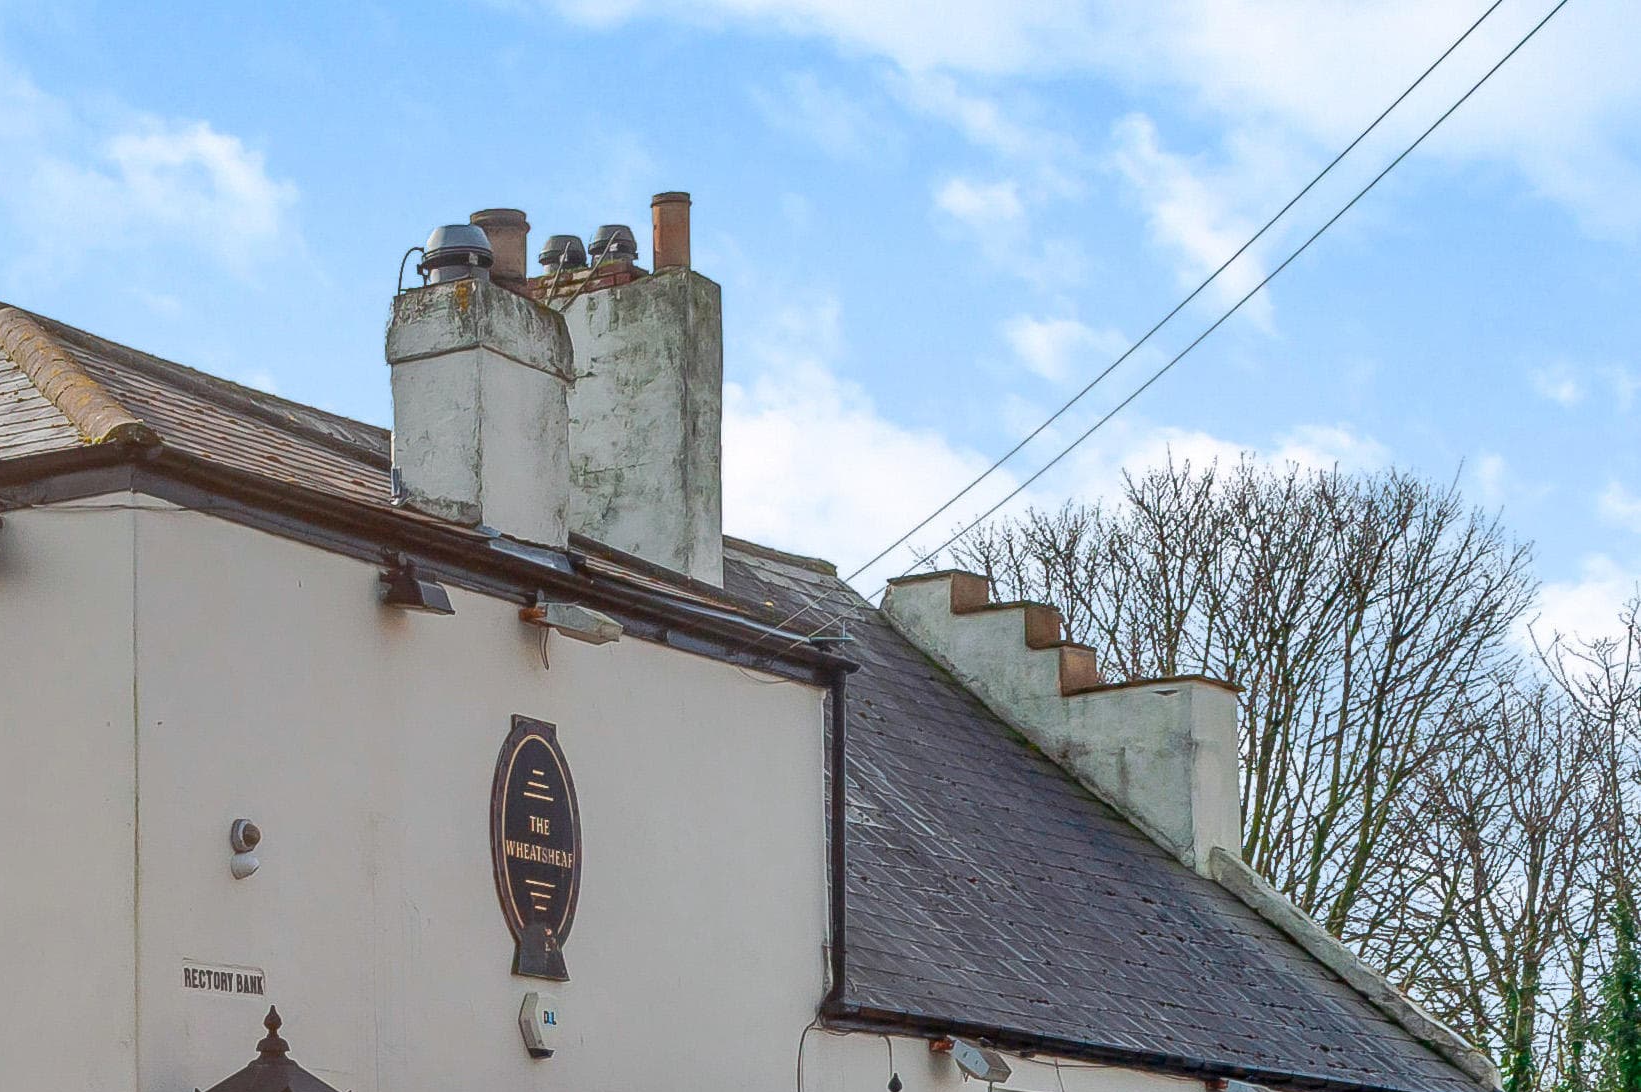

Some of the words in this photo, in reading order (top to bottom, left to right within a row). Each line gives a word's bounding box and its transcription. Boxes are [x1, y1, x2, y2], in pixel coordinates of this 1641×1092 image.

[529, 815, 550, 835] THE
[506, 840, 573, 868] WHEATSHEAF
[183, 967, 233, 992] RECTORY
[236, 973, 263, 995] BANK
